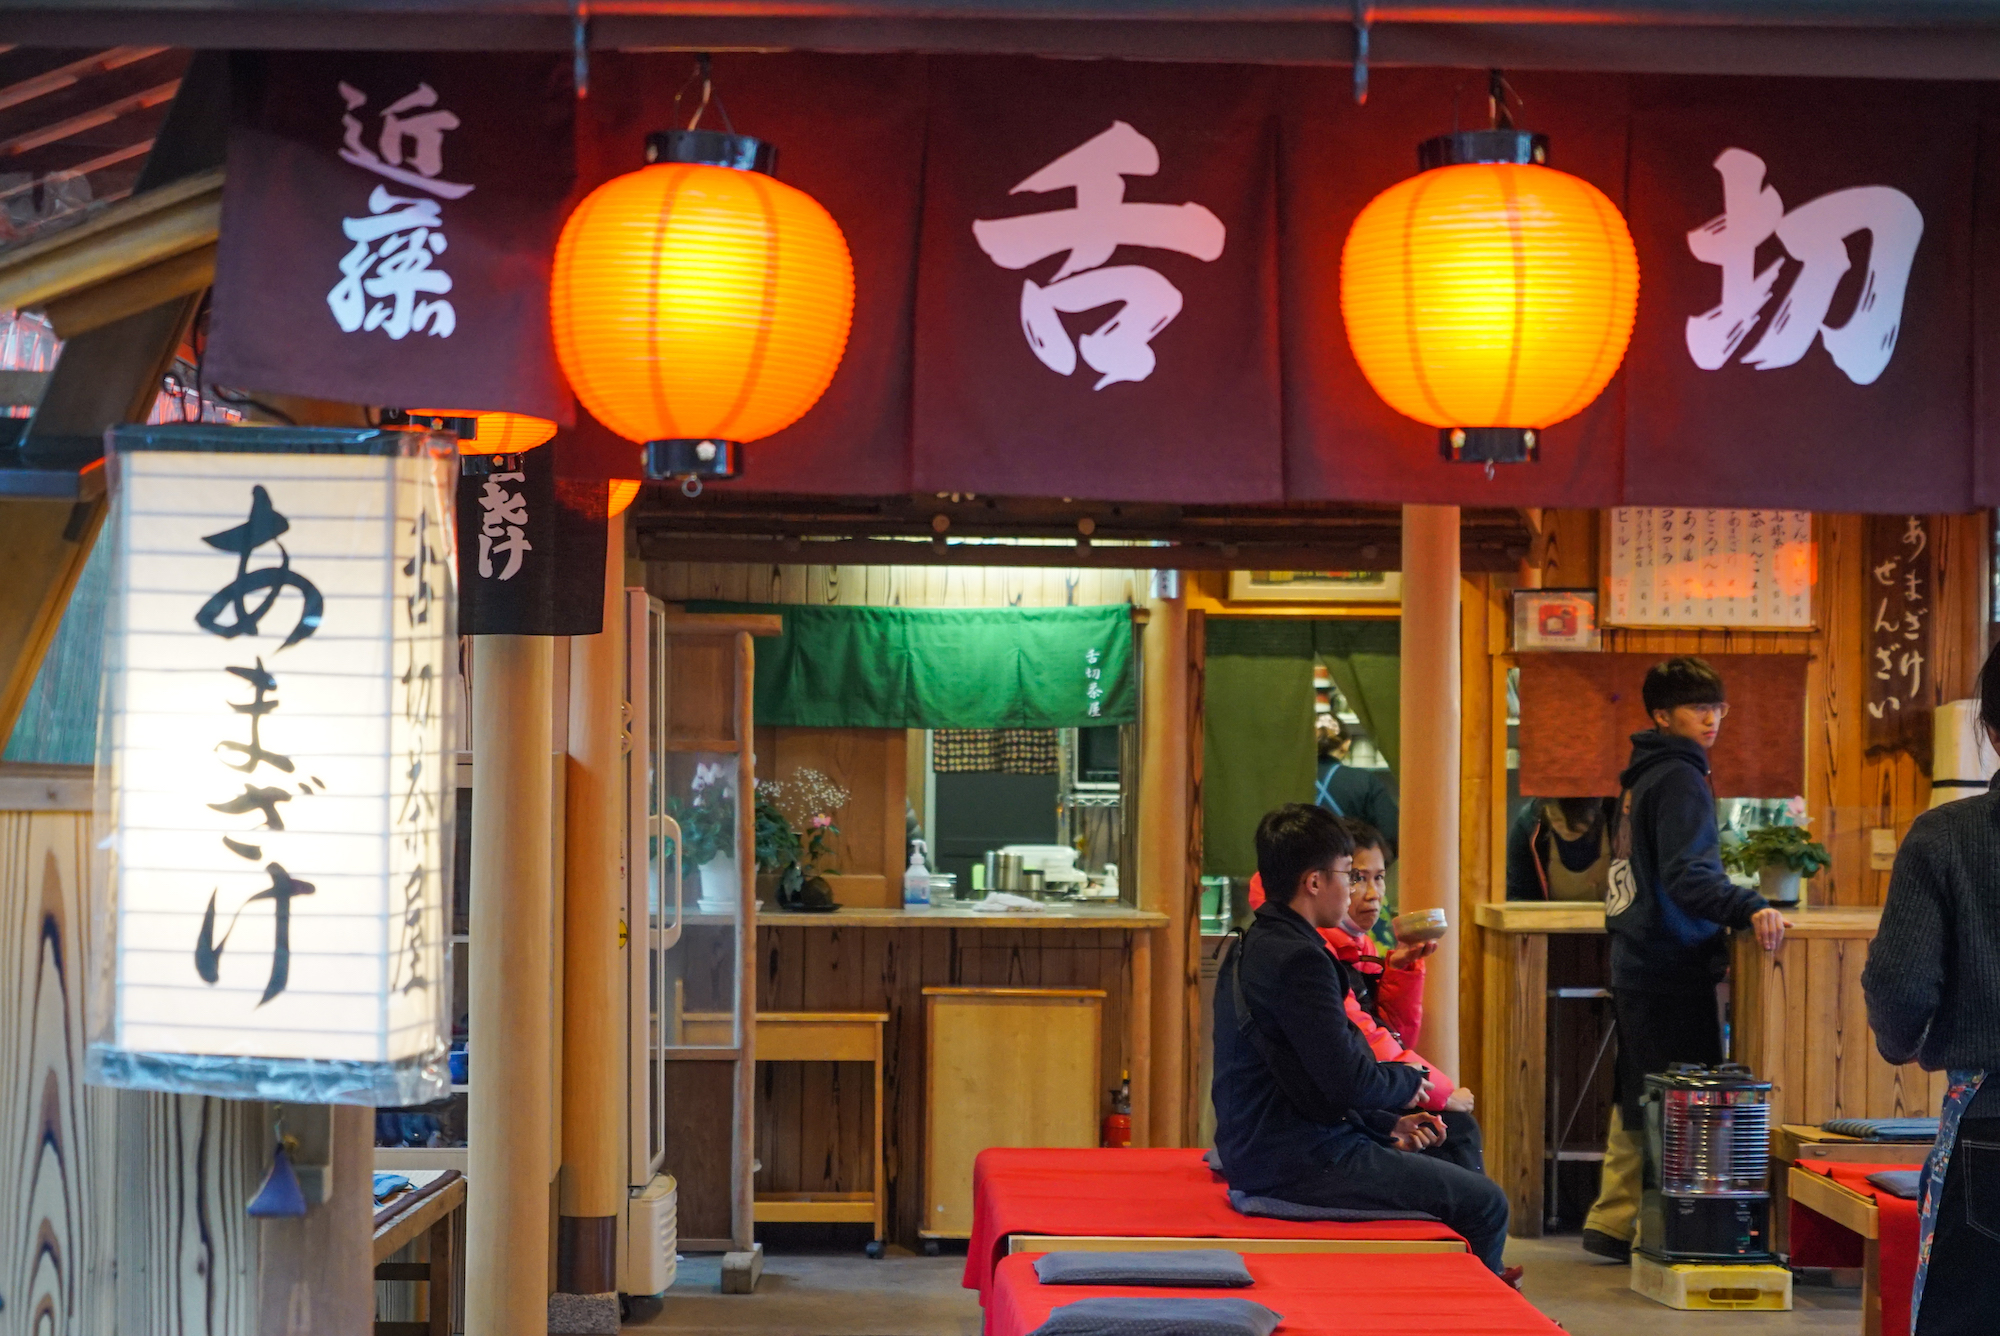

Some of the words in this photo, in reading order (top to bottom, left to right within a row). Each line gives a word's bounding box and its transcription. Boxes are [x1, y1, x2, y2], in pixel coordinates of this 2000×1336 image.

[972, 120, 1226, 391] 舌
[1685, 147, 1925, 386] 切
[1085, 648, 1103, 717] 舌切茶屋
[1868, 554, 1901, 719] ぜんざい
[1899, 516, 1928, 698] あまざけ
[194, 484, 325, 1009] あまざけ
[393, 508, 437, 994] 舌切茶屋
